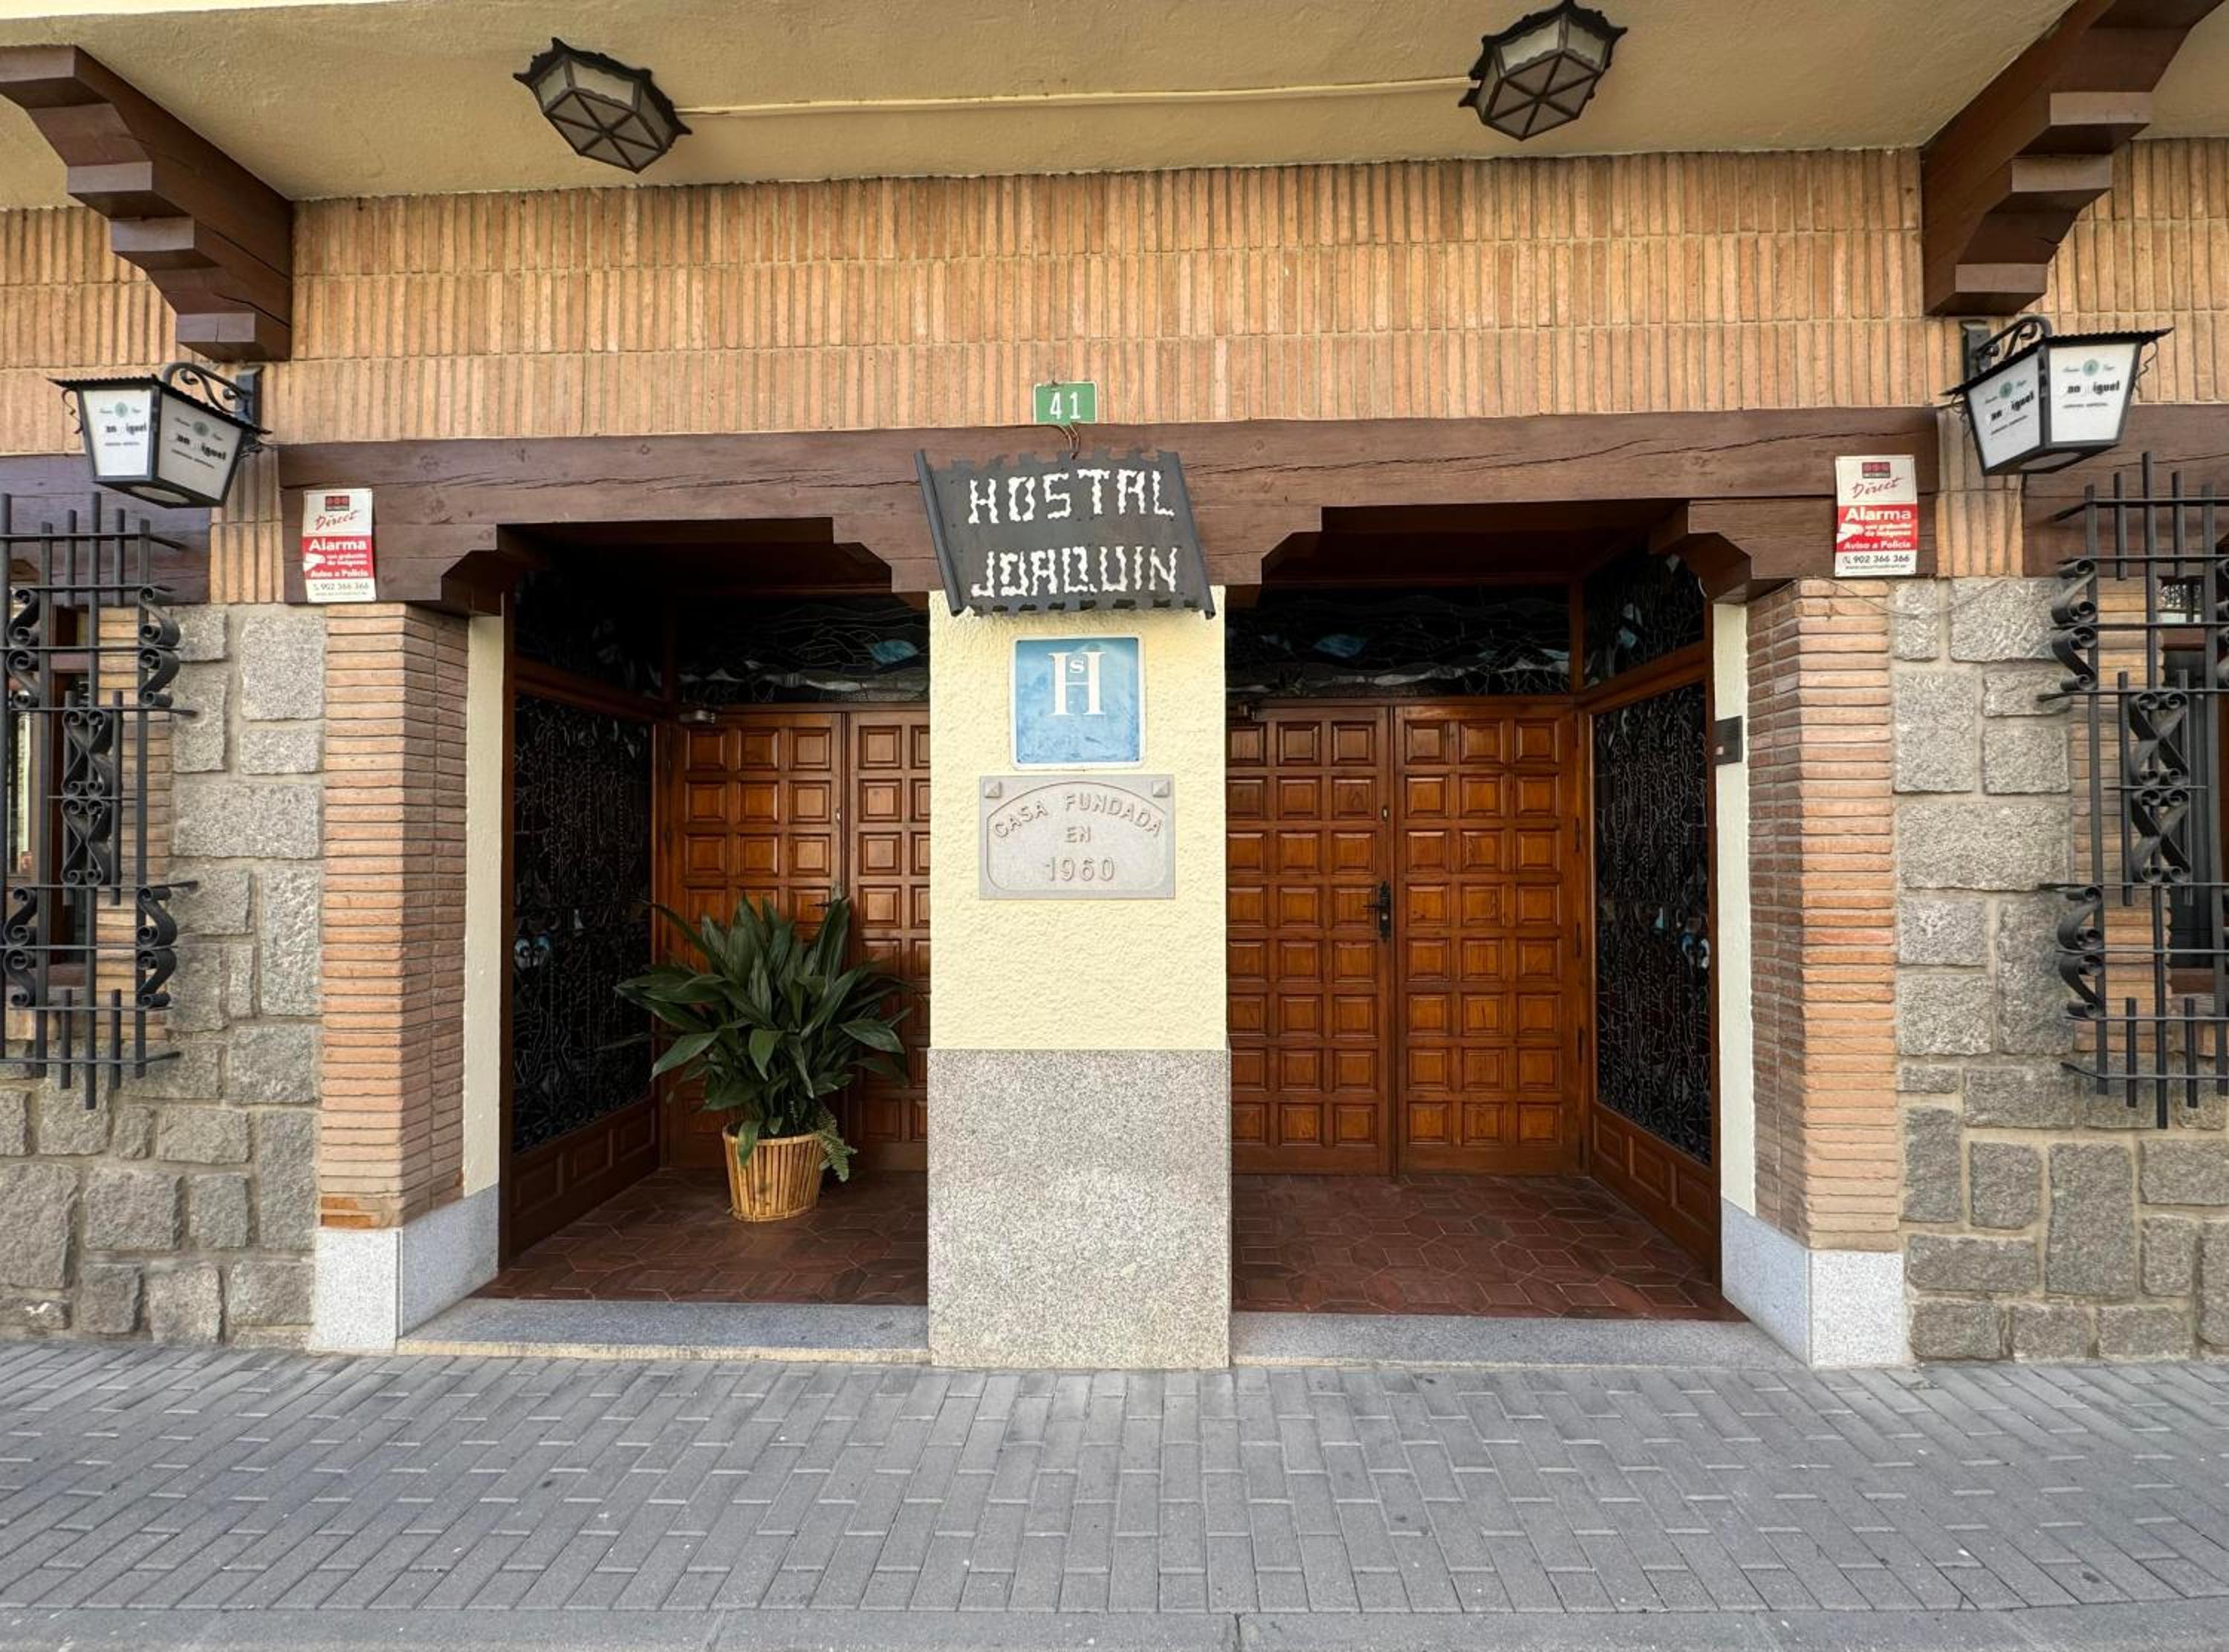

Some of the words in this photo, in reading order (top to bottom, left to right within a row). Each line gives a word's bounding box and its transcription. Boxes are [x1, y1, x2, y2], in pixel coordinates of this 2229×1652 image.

[2089, 380, 2120, 396] iguel
[1050, 391, 1081, 420] 41
[2008, 390, 2035, 412] iguel
[197, 441, 227, 461] iguel
[968, 469, 1175, 524] HOSTAL
[1850, 476, 1903, 498] Direct
[314, 510, 361, 530] Direct
[1846, 507, 1912, 521] Alarma
[309, 539, 366, 551] Alarma
[1843, 542, 1869, 550] Aviso
[1853, 556, 1870, 564] 902
[1874, 555, 1890, 563] 366
[1893, 554, 1910, 562] 366
[970, 546, 1177, 597] JOAQUIN
[995, 801, 1048, 839] CASA
[1065, 793, 1163, 838] FUNDADA
[1064, 826, 1091, 844] EN
[1045, 857, 1116, 882] 1960
